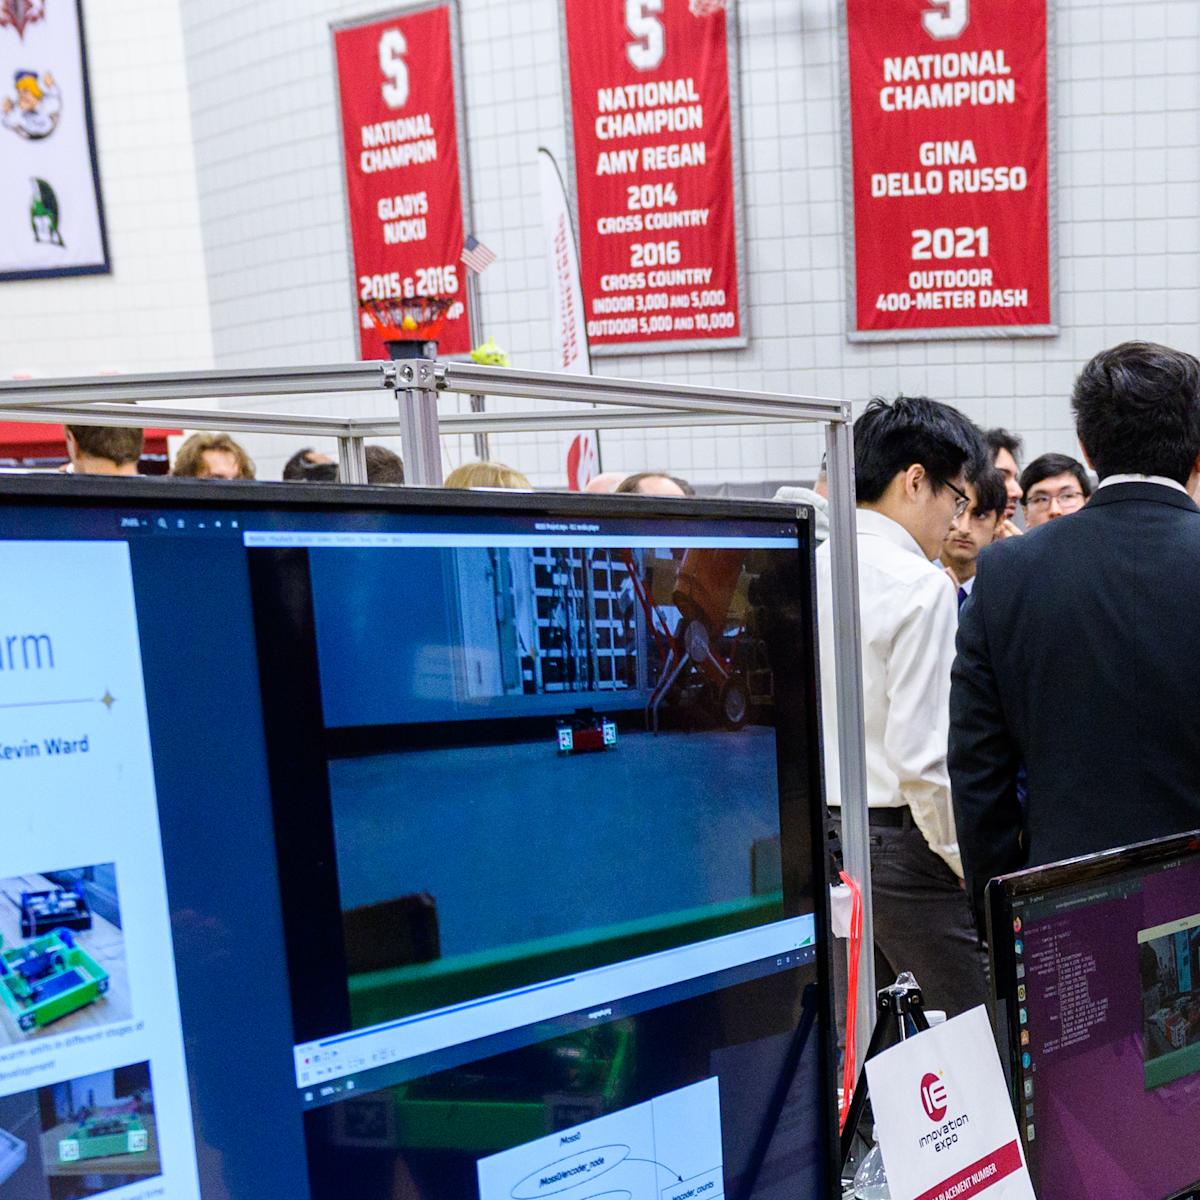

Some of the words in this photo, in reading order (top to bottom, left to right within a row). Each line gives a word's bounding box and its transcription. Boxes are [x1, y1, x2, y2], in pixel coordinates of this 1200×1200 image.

[884, 49, 1011, 82] NATIONAL
[597, 78, 699, 112] NATIONAL
[880, 79, 1015, 112] CHAMPION
[361, 113, 434, 148] NATIONAL
[595, 105, 703, 140] CHAMPION
[360, 138, 437, 174] CHAMPION
[595, 150, 639, 176] AMY
[642, 142, 706, 172] REGAN
[919, 140, 977, 166] GINA
[871, 170, 943, 197] DELLO
[948, 166, 1027, 193] RUSSO
[627, 183, 678, 211] 2014
[597, 213, 643, 235] CROSS
[645, 208, 709, 231] COUNTRY
[630, 241, 680, 268] 2016
[911, 226, 989, 260] 2021
[360, 272, 401, 300] 2015
[415, 265, 458, 294] 2016
[600, 273, 646, 291] CROSS
[648, 267, 712, 289] COUNTRY
[909, 269, 992, 289] OUTDOOR
[592, 296, 634, 314] INDOOR
[635, 293, 668, 312] 3,000
[690, 290, 725, 308] 5,000
[876, 291, 976, 312] 400-METER
[979, 288, 1028, 308] DASH
[639, 315, 672, 333] 5,000
[695, 312, 734, 331] 10,000
[44, 734, 89, 755] Ward
[919, 1114, 969, 1148] innovation
[934, 1133, 958, 1153] expo
[971, 1162, 998, 1188] NUMBER
